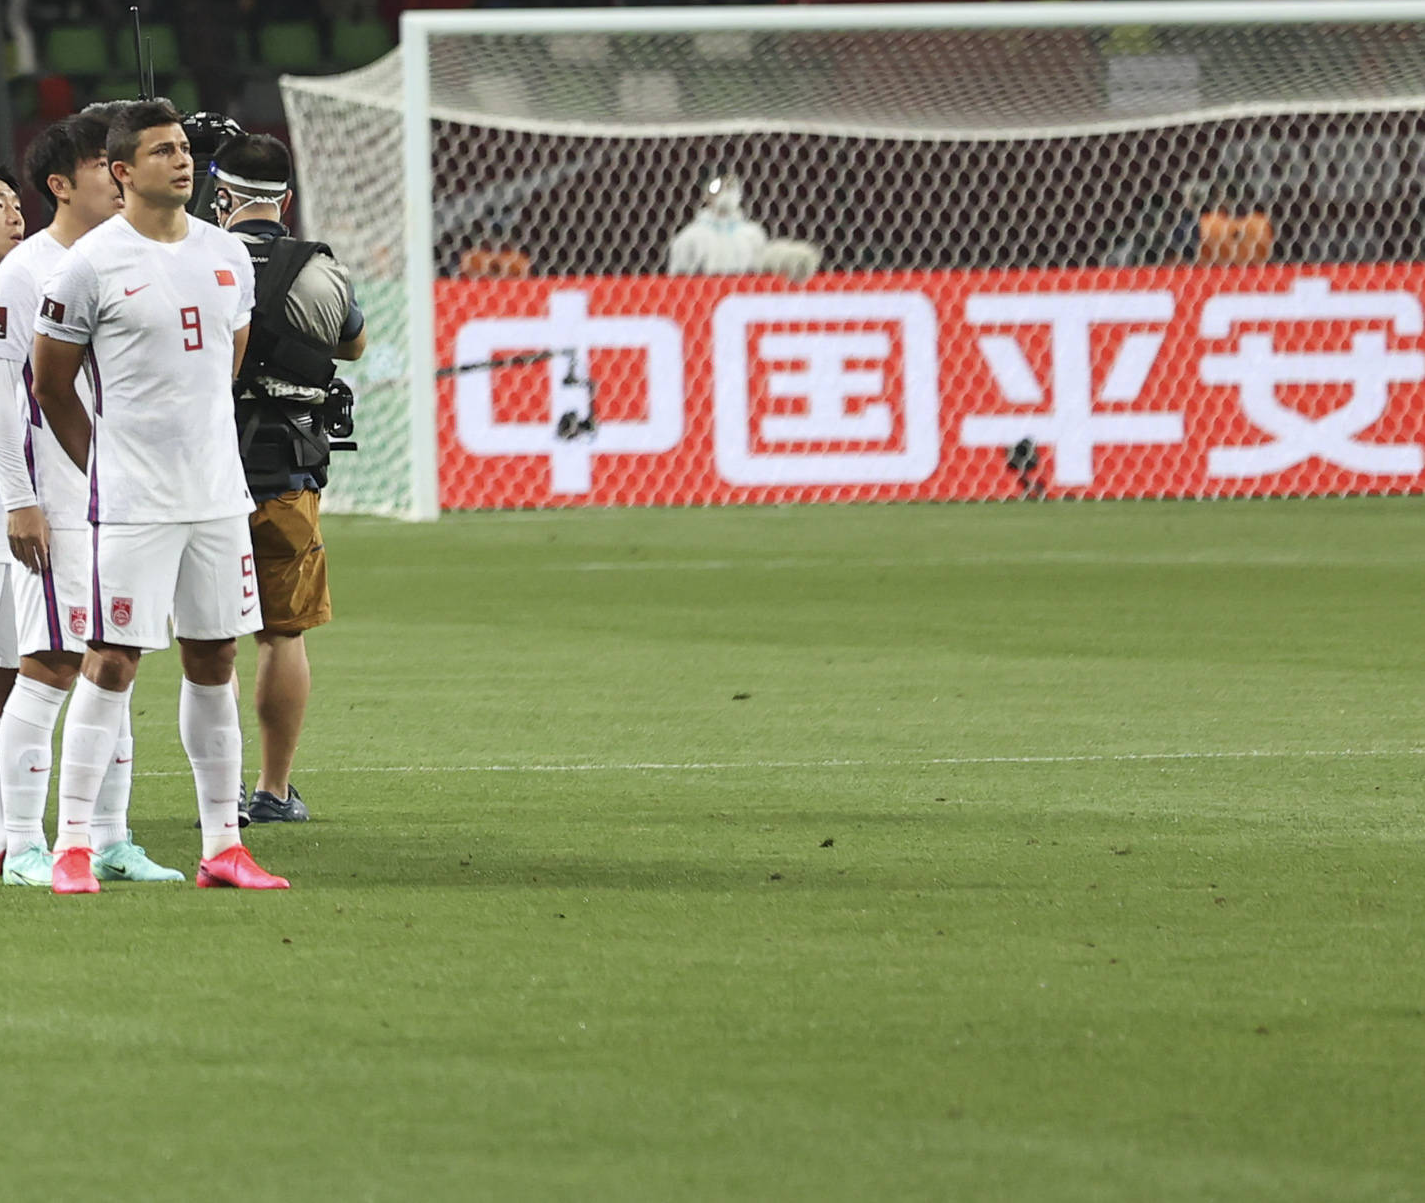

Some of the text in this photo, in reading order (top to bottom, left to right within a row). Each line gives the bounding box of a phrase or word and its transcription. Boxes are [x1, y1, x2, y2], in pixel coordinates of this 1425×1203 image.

[180, 306, 203, 352] 9
[455, 277, 1425, 495] 中国平安
[241, 553, 253, 598] 9
